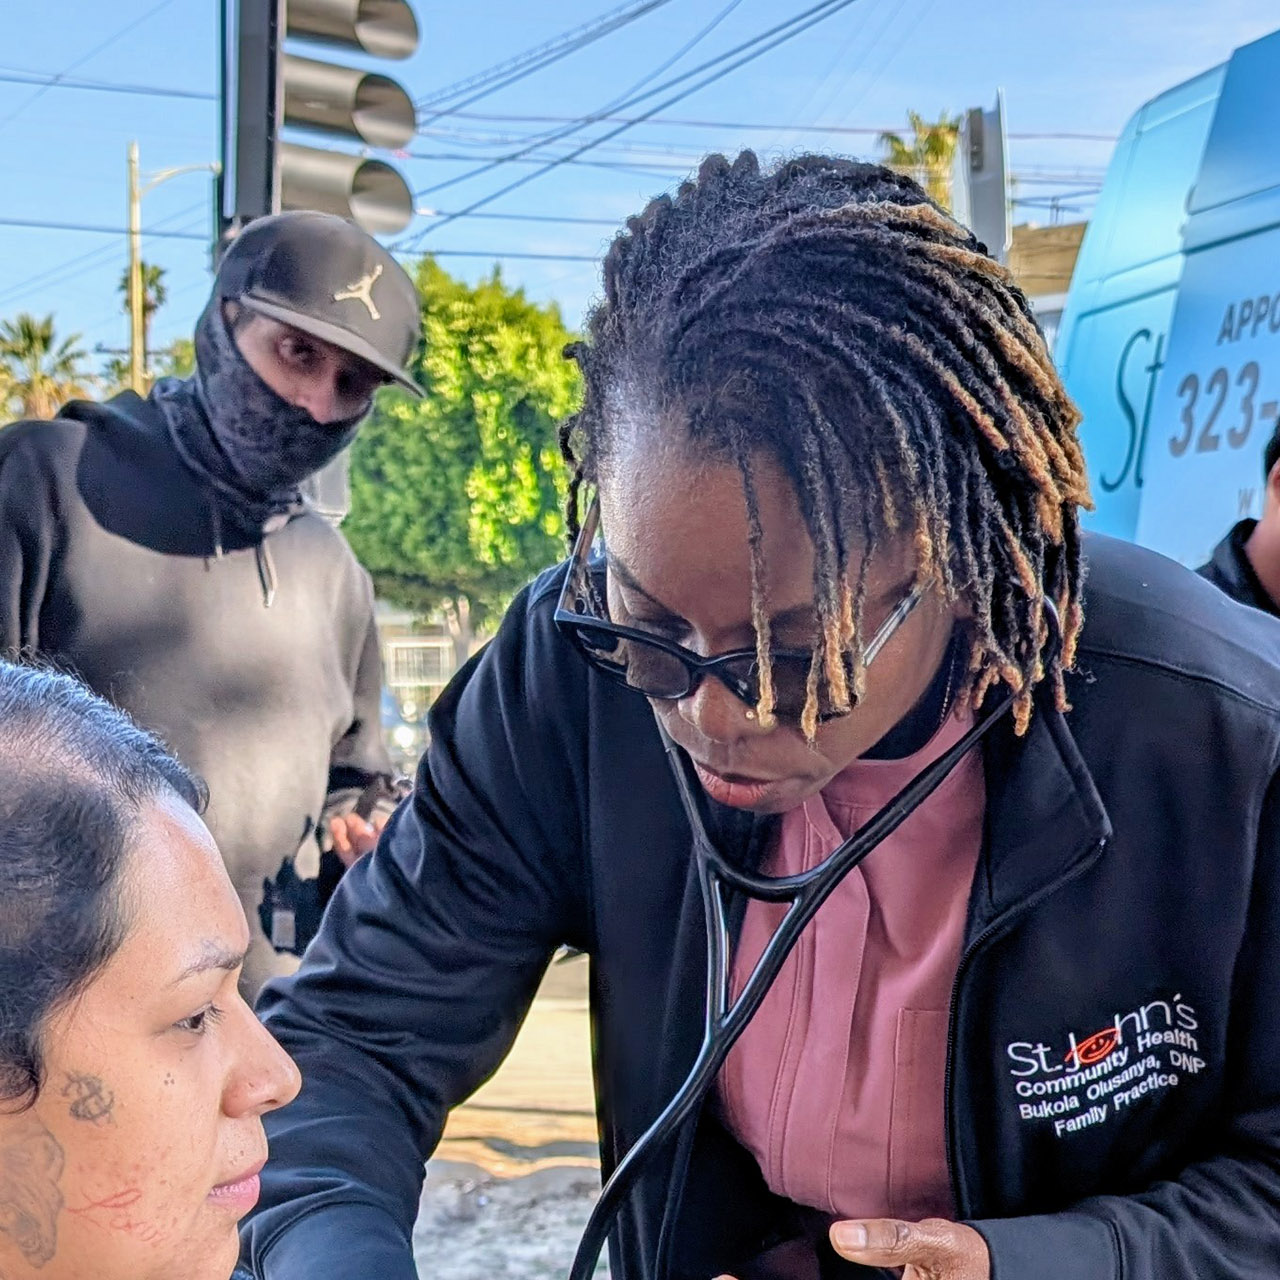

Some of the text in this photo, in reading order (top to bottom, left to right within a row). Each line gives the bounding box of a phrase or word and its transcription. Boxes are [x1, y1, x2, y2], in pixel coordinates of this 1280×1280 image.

[1015, 1029, 1199, 1098] Community Health
[1019, 1049, 1206, 1120] Bukola Olusanya, DNP
[1054, 1072, 1179, 1138] Family Practice
